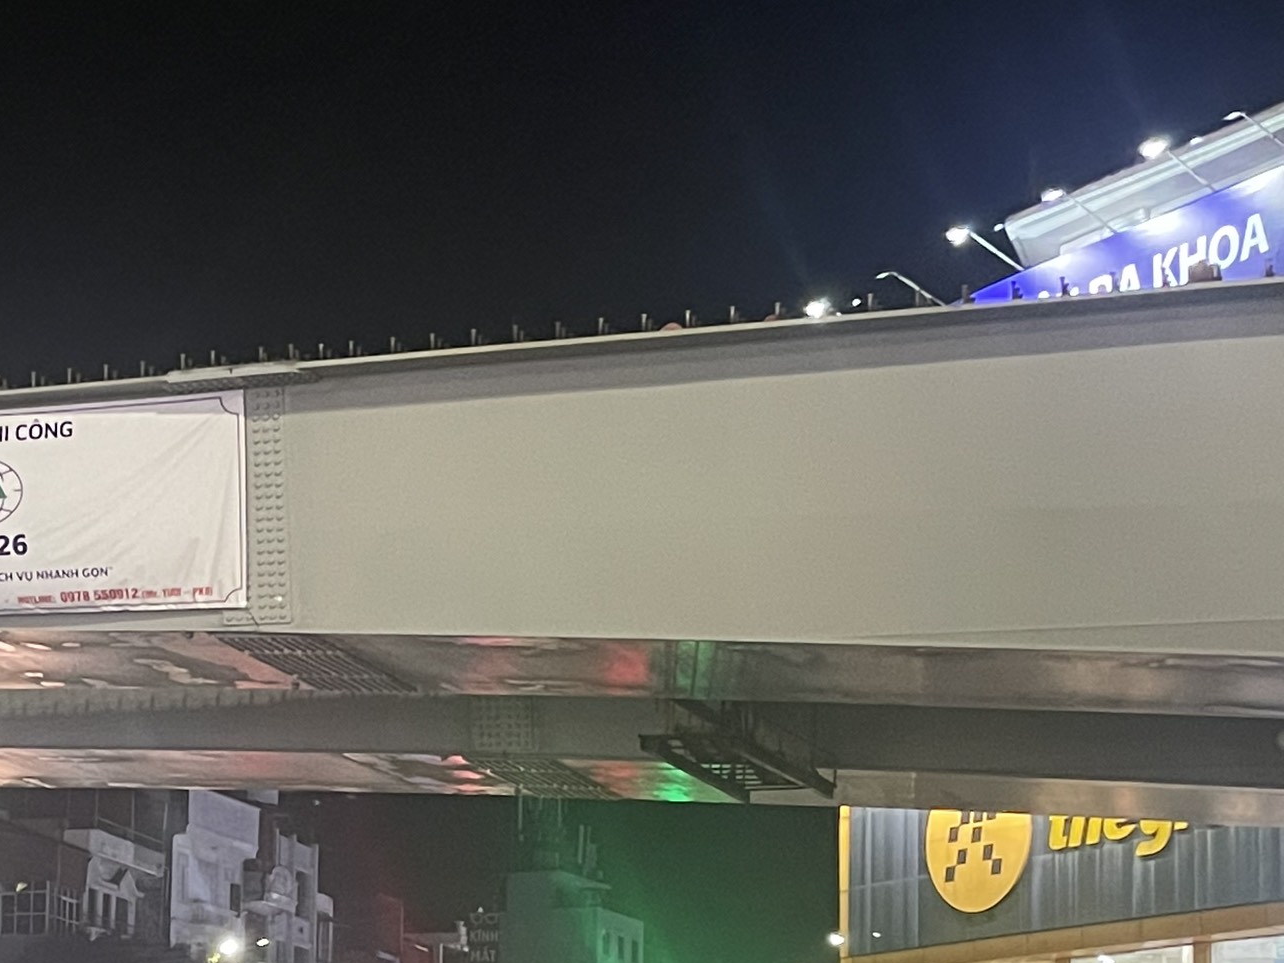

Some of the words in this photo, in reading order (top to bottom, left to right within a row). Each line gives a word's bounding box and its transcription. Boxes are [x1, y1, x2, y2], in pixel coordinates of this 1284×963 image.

[15, 419, 74, 441] CÔNG
[15, 570, 33, 582] VỤ
[36, 569, 79, 581] NHANH
[60, 590, 90, 603] 0978
